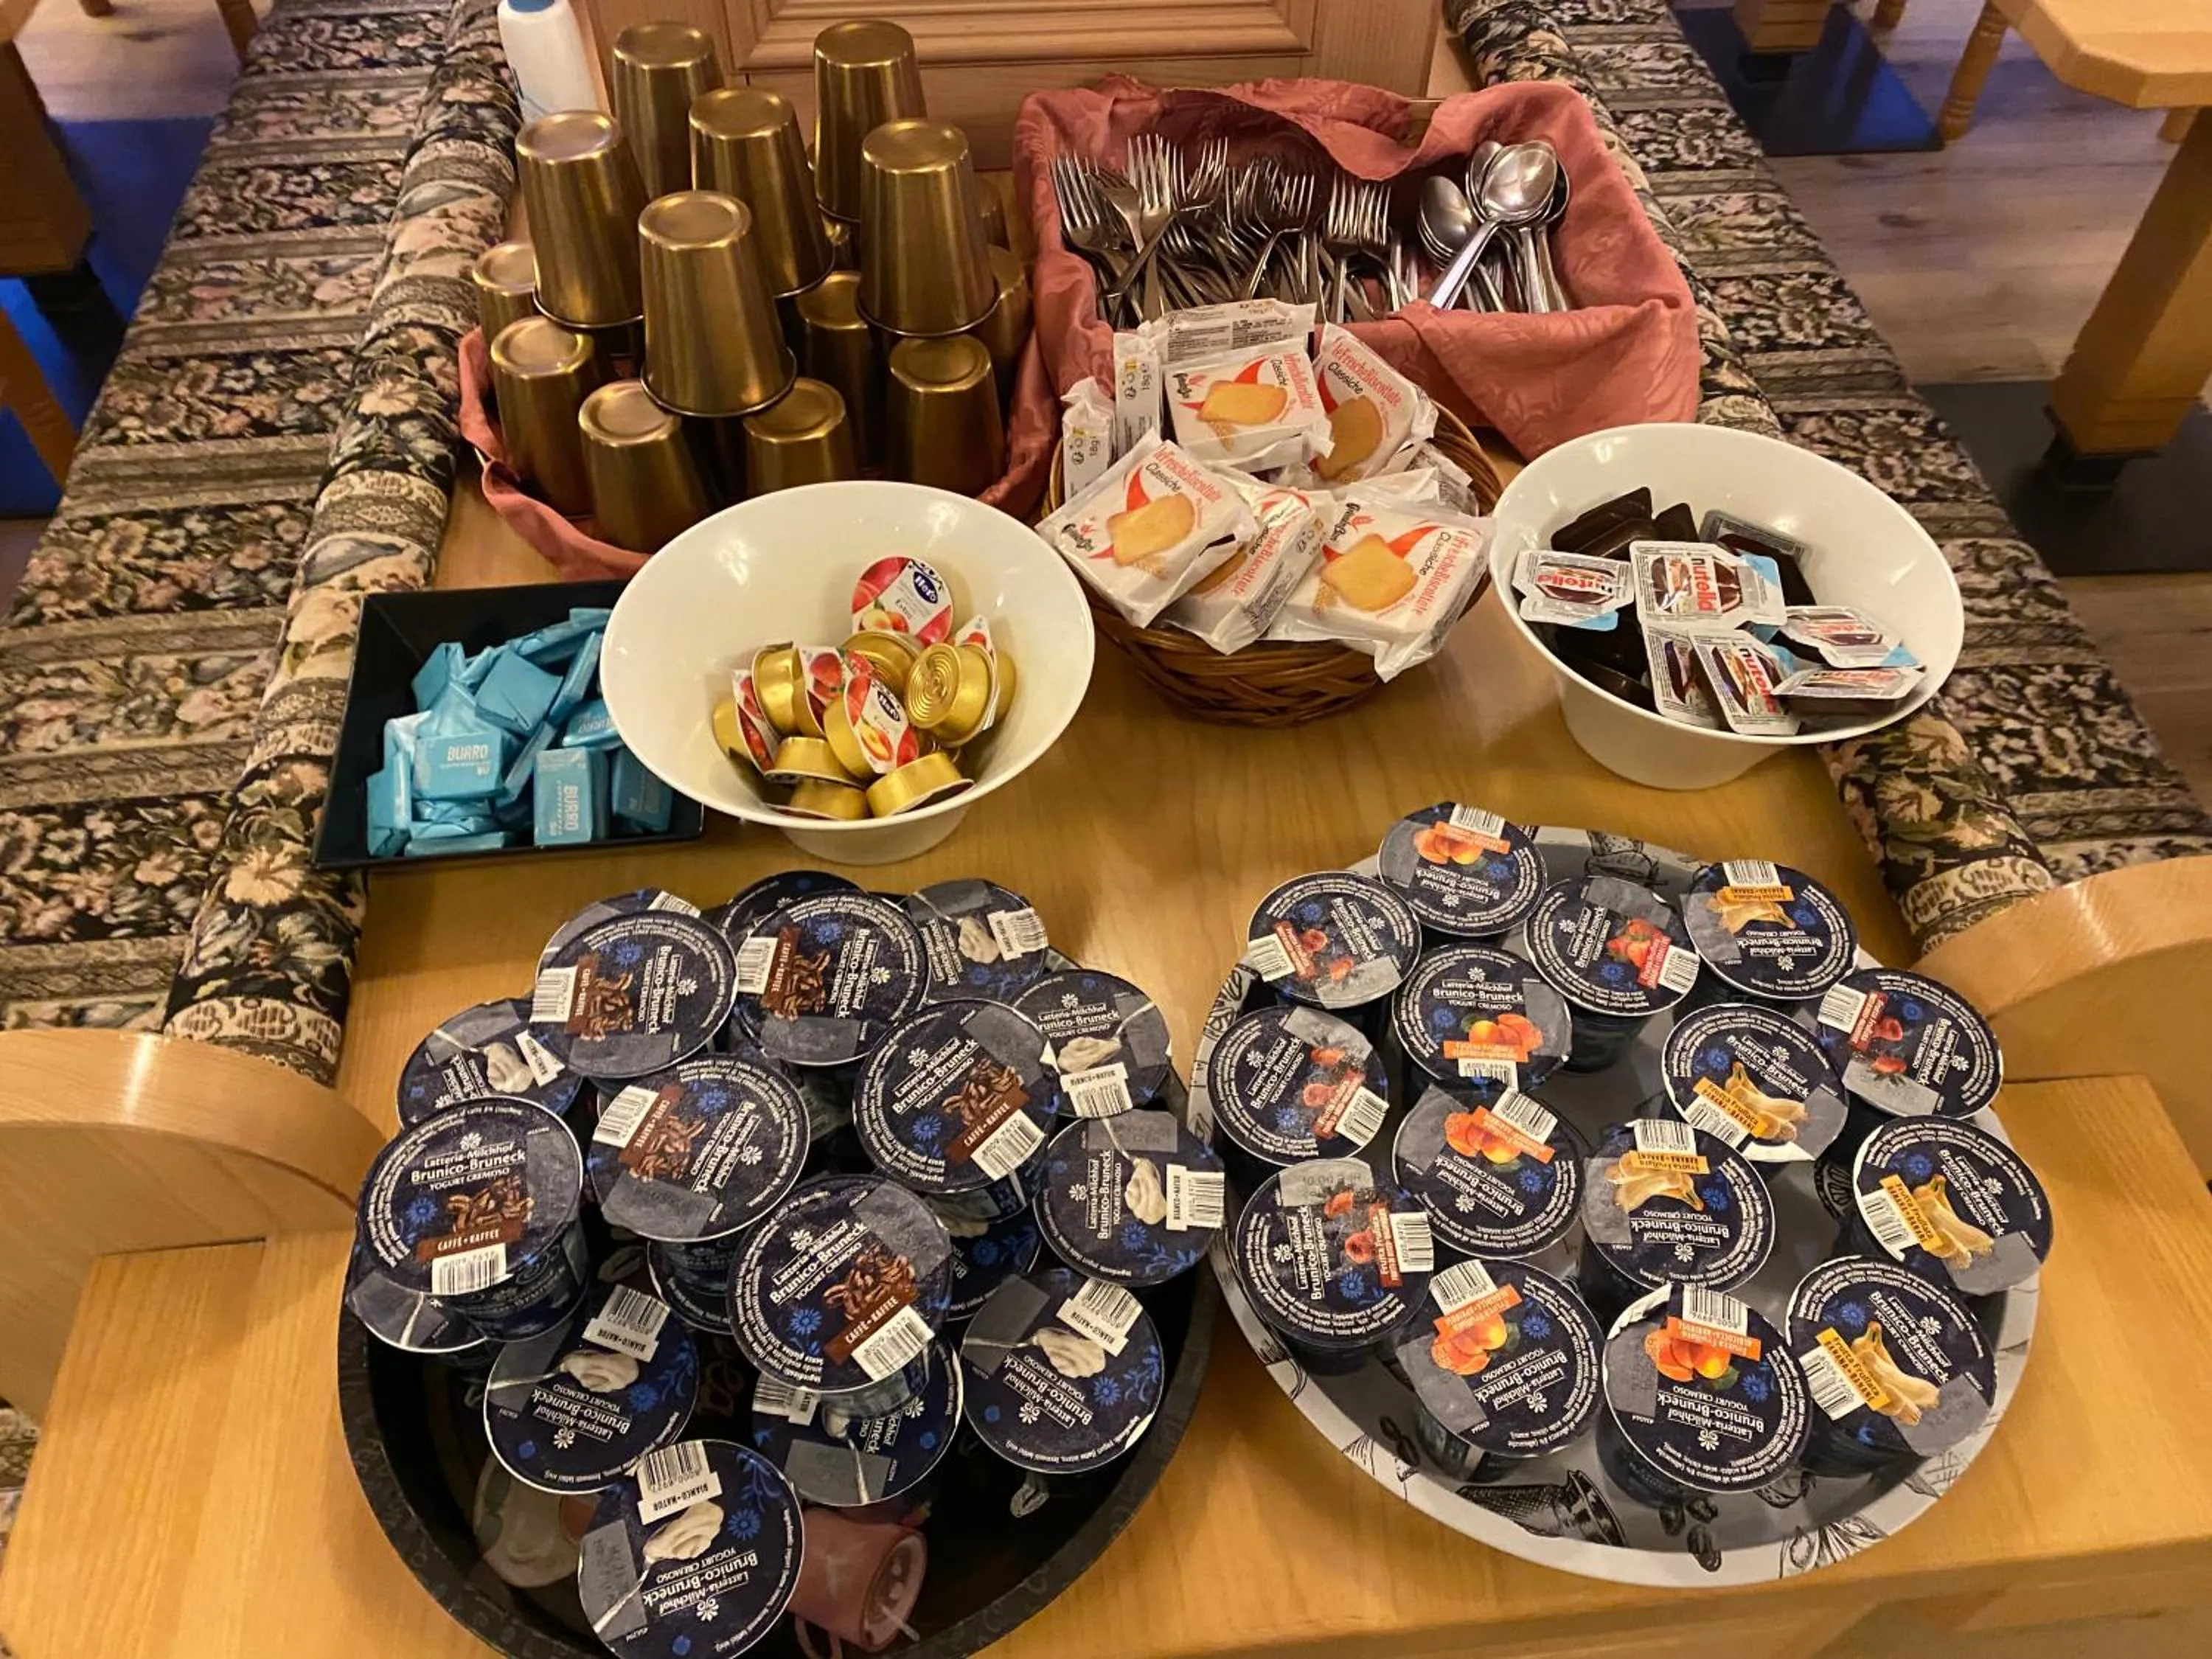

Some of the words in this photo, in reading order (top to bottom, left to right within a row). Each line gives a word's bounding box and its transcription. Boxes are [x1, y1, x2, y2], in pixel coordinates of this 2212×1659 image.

[1537, 573, 1613, 593] nutella
[1691, 557, 1717, 611] nutella
[448, 745, 488, 762] BURRO
[563, 785, 580, 832] BURRO
[838, 928, 869, 1018] Brunico-Bruneck
[1433, 988, 1523, 1002] Brunico-Bruneck
[1037, 1011, 1119, 1032] runico-Bruneck
[893, 1040, 978, 1113] Brunico-Bruneck
[895, 1040, 960, 1097] Latteria-Milchhof
[1251, 1037, 1301, 1109] Brunico-Bruneck
[411, 1150, 526, 1183] Brunico-Bruneck
[424, 1142, 514, 1167] Latteria-Milchhof
[695, 1101, 755, 1192] Brunico-Bruneck
[1098, 1150, 1114, 1239] Brunico-Bruneck
[1436, 1155, 1523, 1215] Brunico-Bruneck
[773, 1221, 848, 1285] Latteria-Milchhof
[1290, 1216, 1309, 1290] Latteria-Milchhof
[1298, 1204, 1322, 1300] Brunico-Bruneck
[1631, 1217, 1729, 1239] Brunico-Bruneck
[1644, 1231, 1719, 1245] Latteria-Milchhof
[771, 1222, 867, 1303] Brunico-Bruneck
[1870, 1292, 1948, 1382] Brunico-Bruneck
[1888, 1297, 1951, 1367] Latteria-Milchhof
[1005, 1357, 1092, 1425] Brunico-Bruneck
[1006, 1373, 1076, 1426] Latteria-Milchhof
[1474, 1352, 1567, 1401] Brunico-Bruneck
[1492, 1368, 1564, 1406] Latteria-Milchhof
[533, 1390, 630, 1433] Brunico-Bruneck
[536, 1405, 613, 1439] Latteria-Milchhof
[1658, 1391, 1764, 1432] Brunico-Bruneck
[1668, 1408, 1753, 1438] Latteria-Milchhof
[644, 1554, 757, 1606] Brunico-Bruneck
[701, 1548, 736, 1567] YOGURT
[659, 1572, 748, 1614] Latteria-Milchhof
